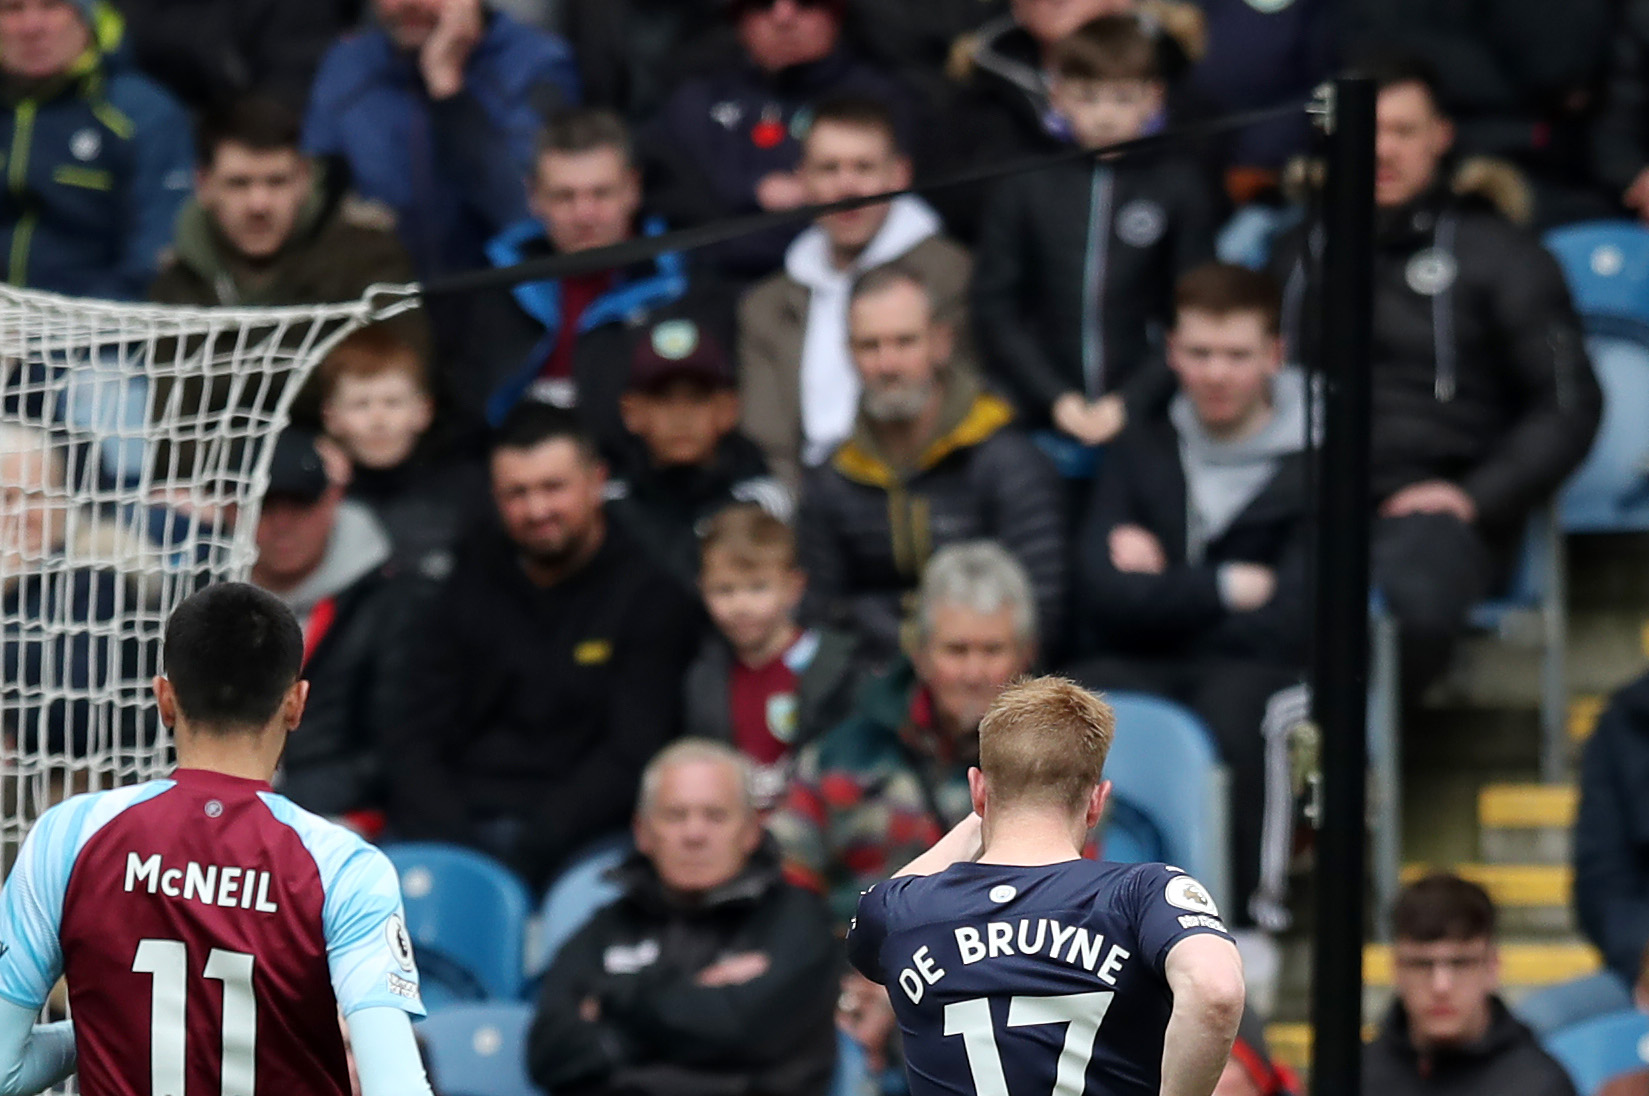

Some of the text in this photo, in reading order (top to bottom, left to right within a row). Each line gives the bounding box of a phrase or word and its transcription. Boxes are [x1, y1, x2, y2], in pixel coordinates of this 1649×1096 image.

[123, 851, 279, 913] McNEIL
[898, 918, 1131, 1005] DE BRUYNE
